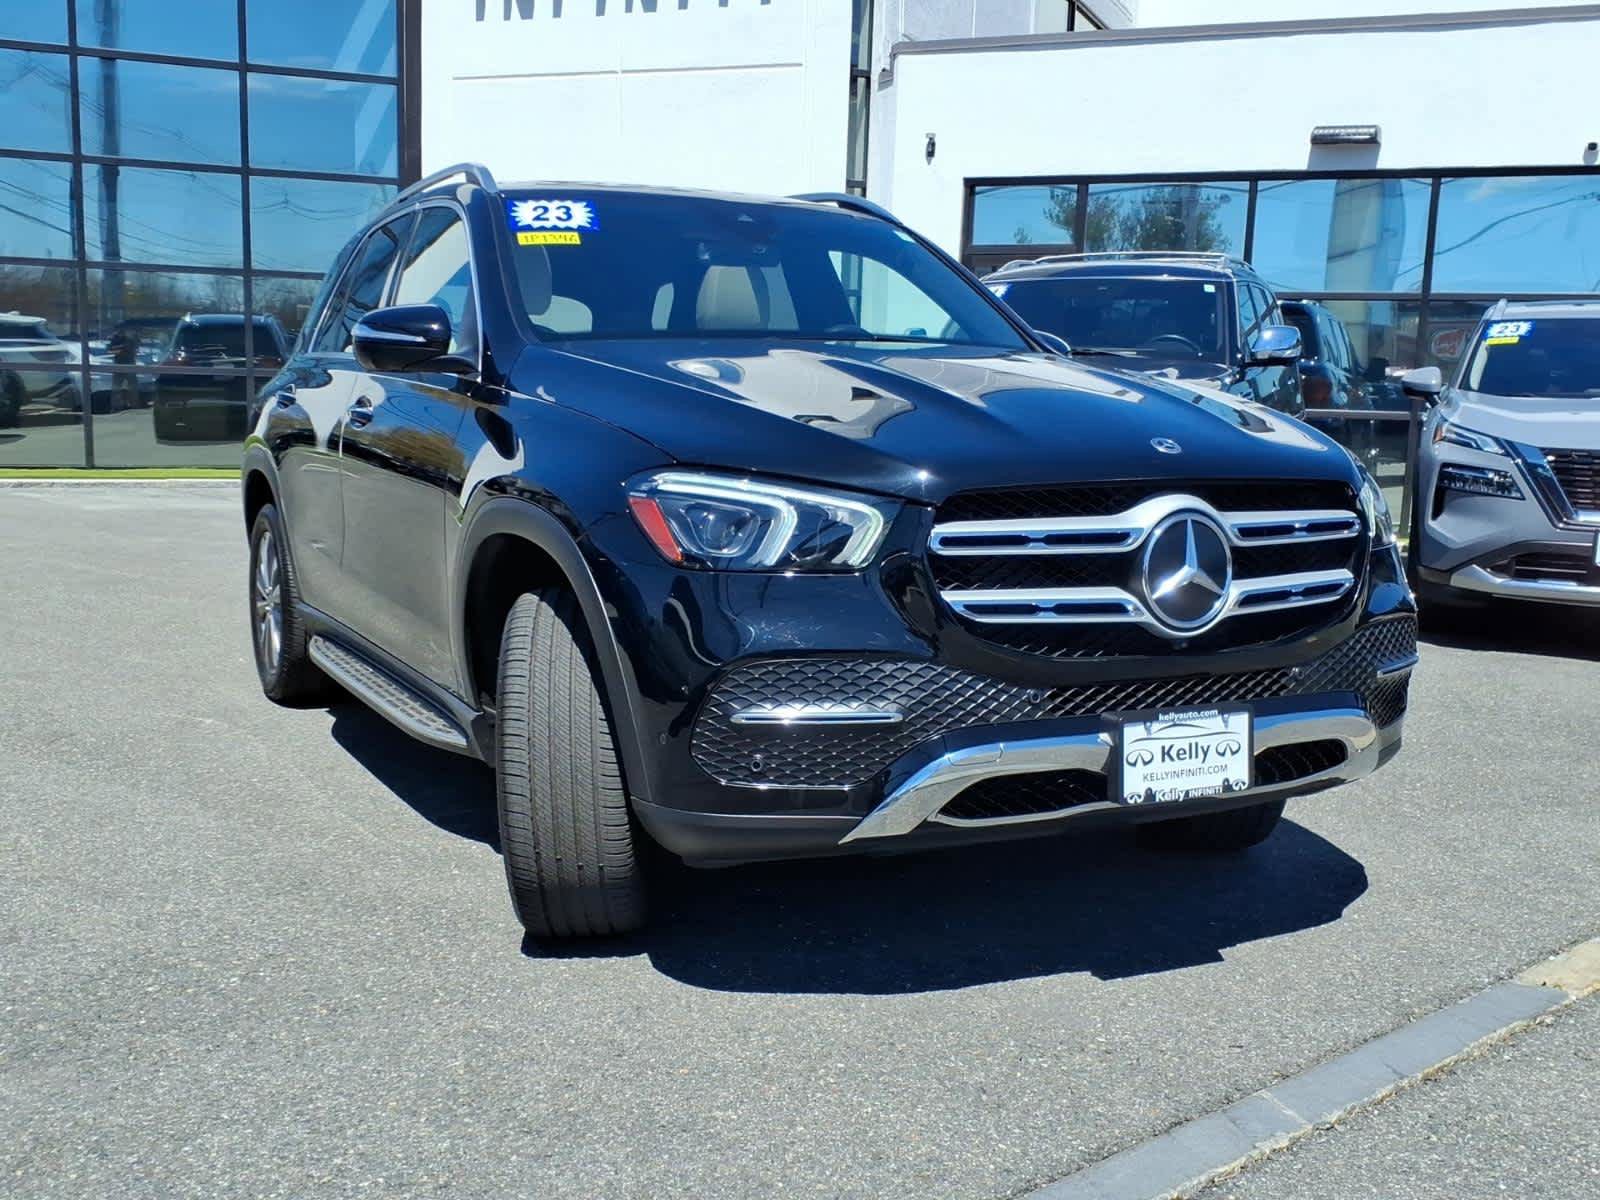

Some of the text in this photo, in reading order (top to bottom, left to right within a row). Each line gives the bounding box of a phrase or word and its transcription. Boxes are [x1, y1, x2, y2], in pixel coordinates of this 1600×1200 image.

[532, 205, 573, 222] 23
[1158, 710, 1218, 721] kellyauto.com
[1161, 741, 1211, 763] Kelly
[1144, 764, 1227, 782] KELLYINFINITI.COM
[1155, 787, 1185, 803] Kelly
